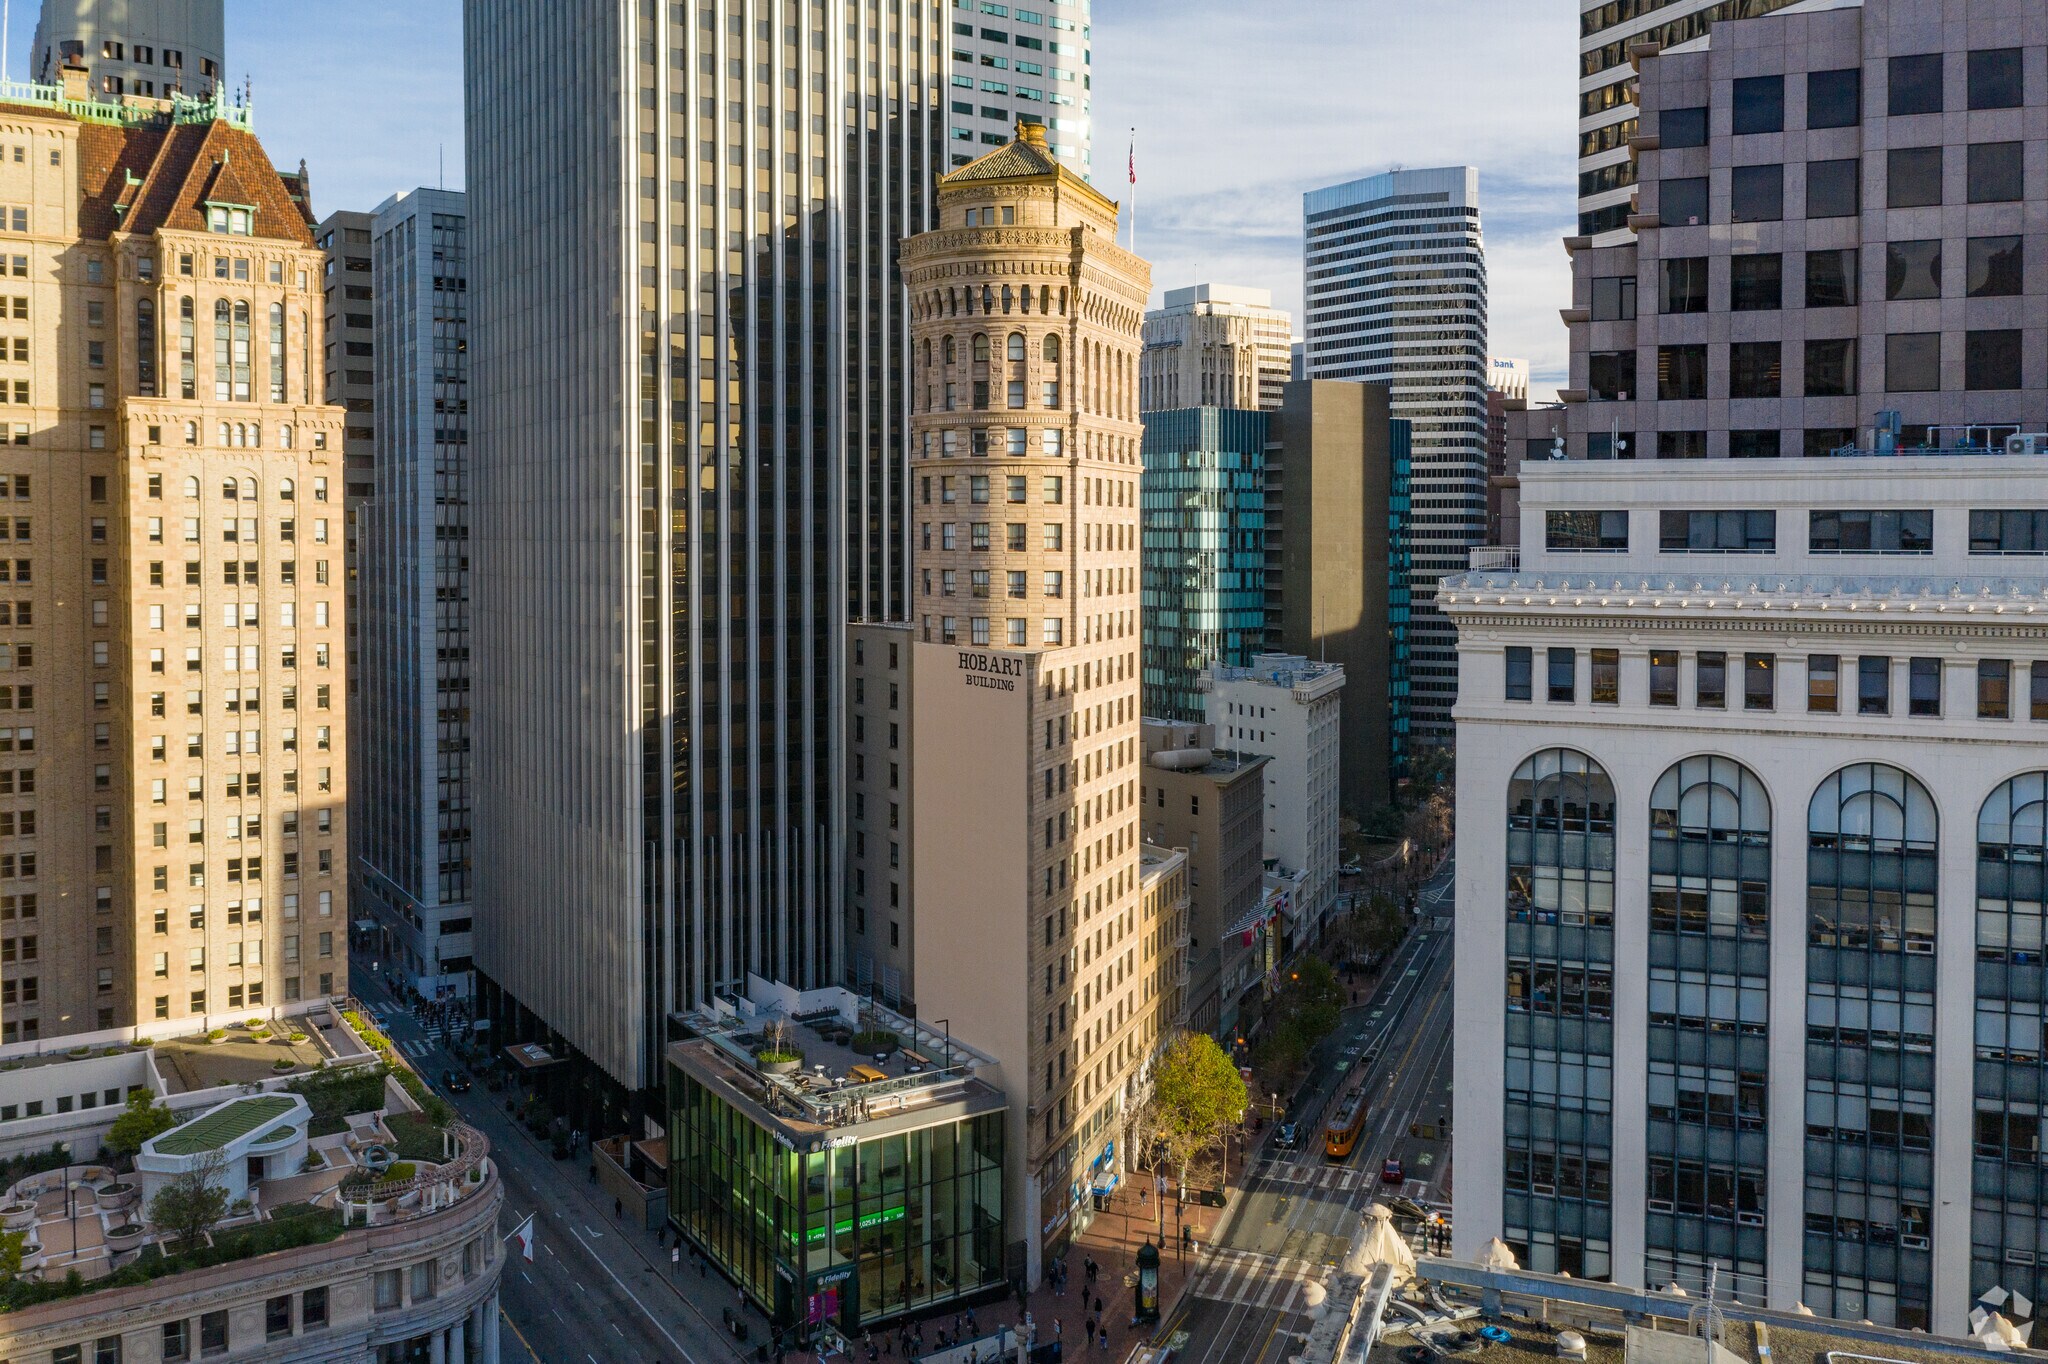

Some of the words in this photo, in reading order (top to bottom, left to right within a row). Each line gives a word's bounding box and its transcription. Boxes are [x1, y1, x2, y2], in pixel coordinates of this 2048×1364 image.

[1494, 359, 1514, 369] bank
[958, 652, 1023, 677] HOBART
[966, 674, 1015, 692] BUILDING
[821, 1135, 858, 1151] Fidelity
[824, 1271, 852, 1284] Fidelity
